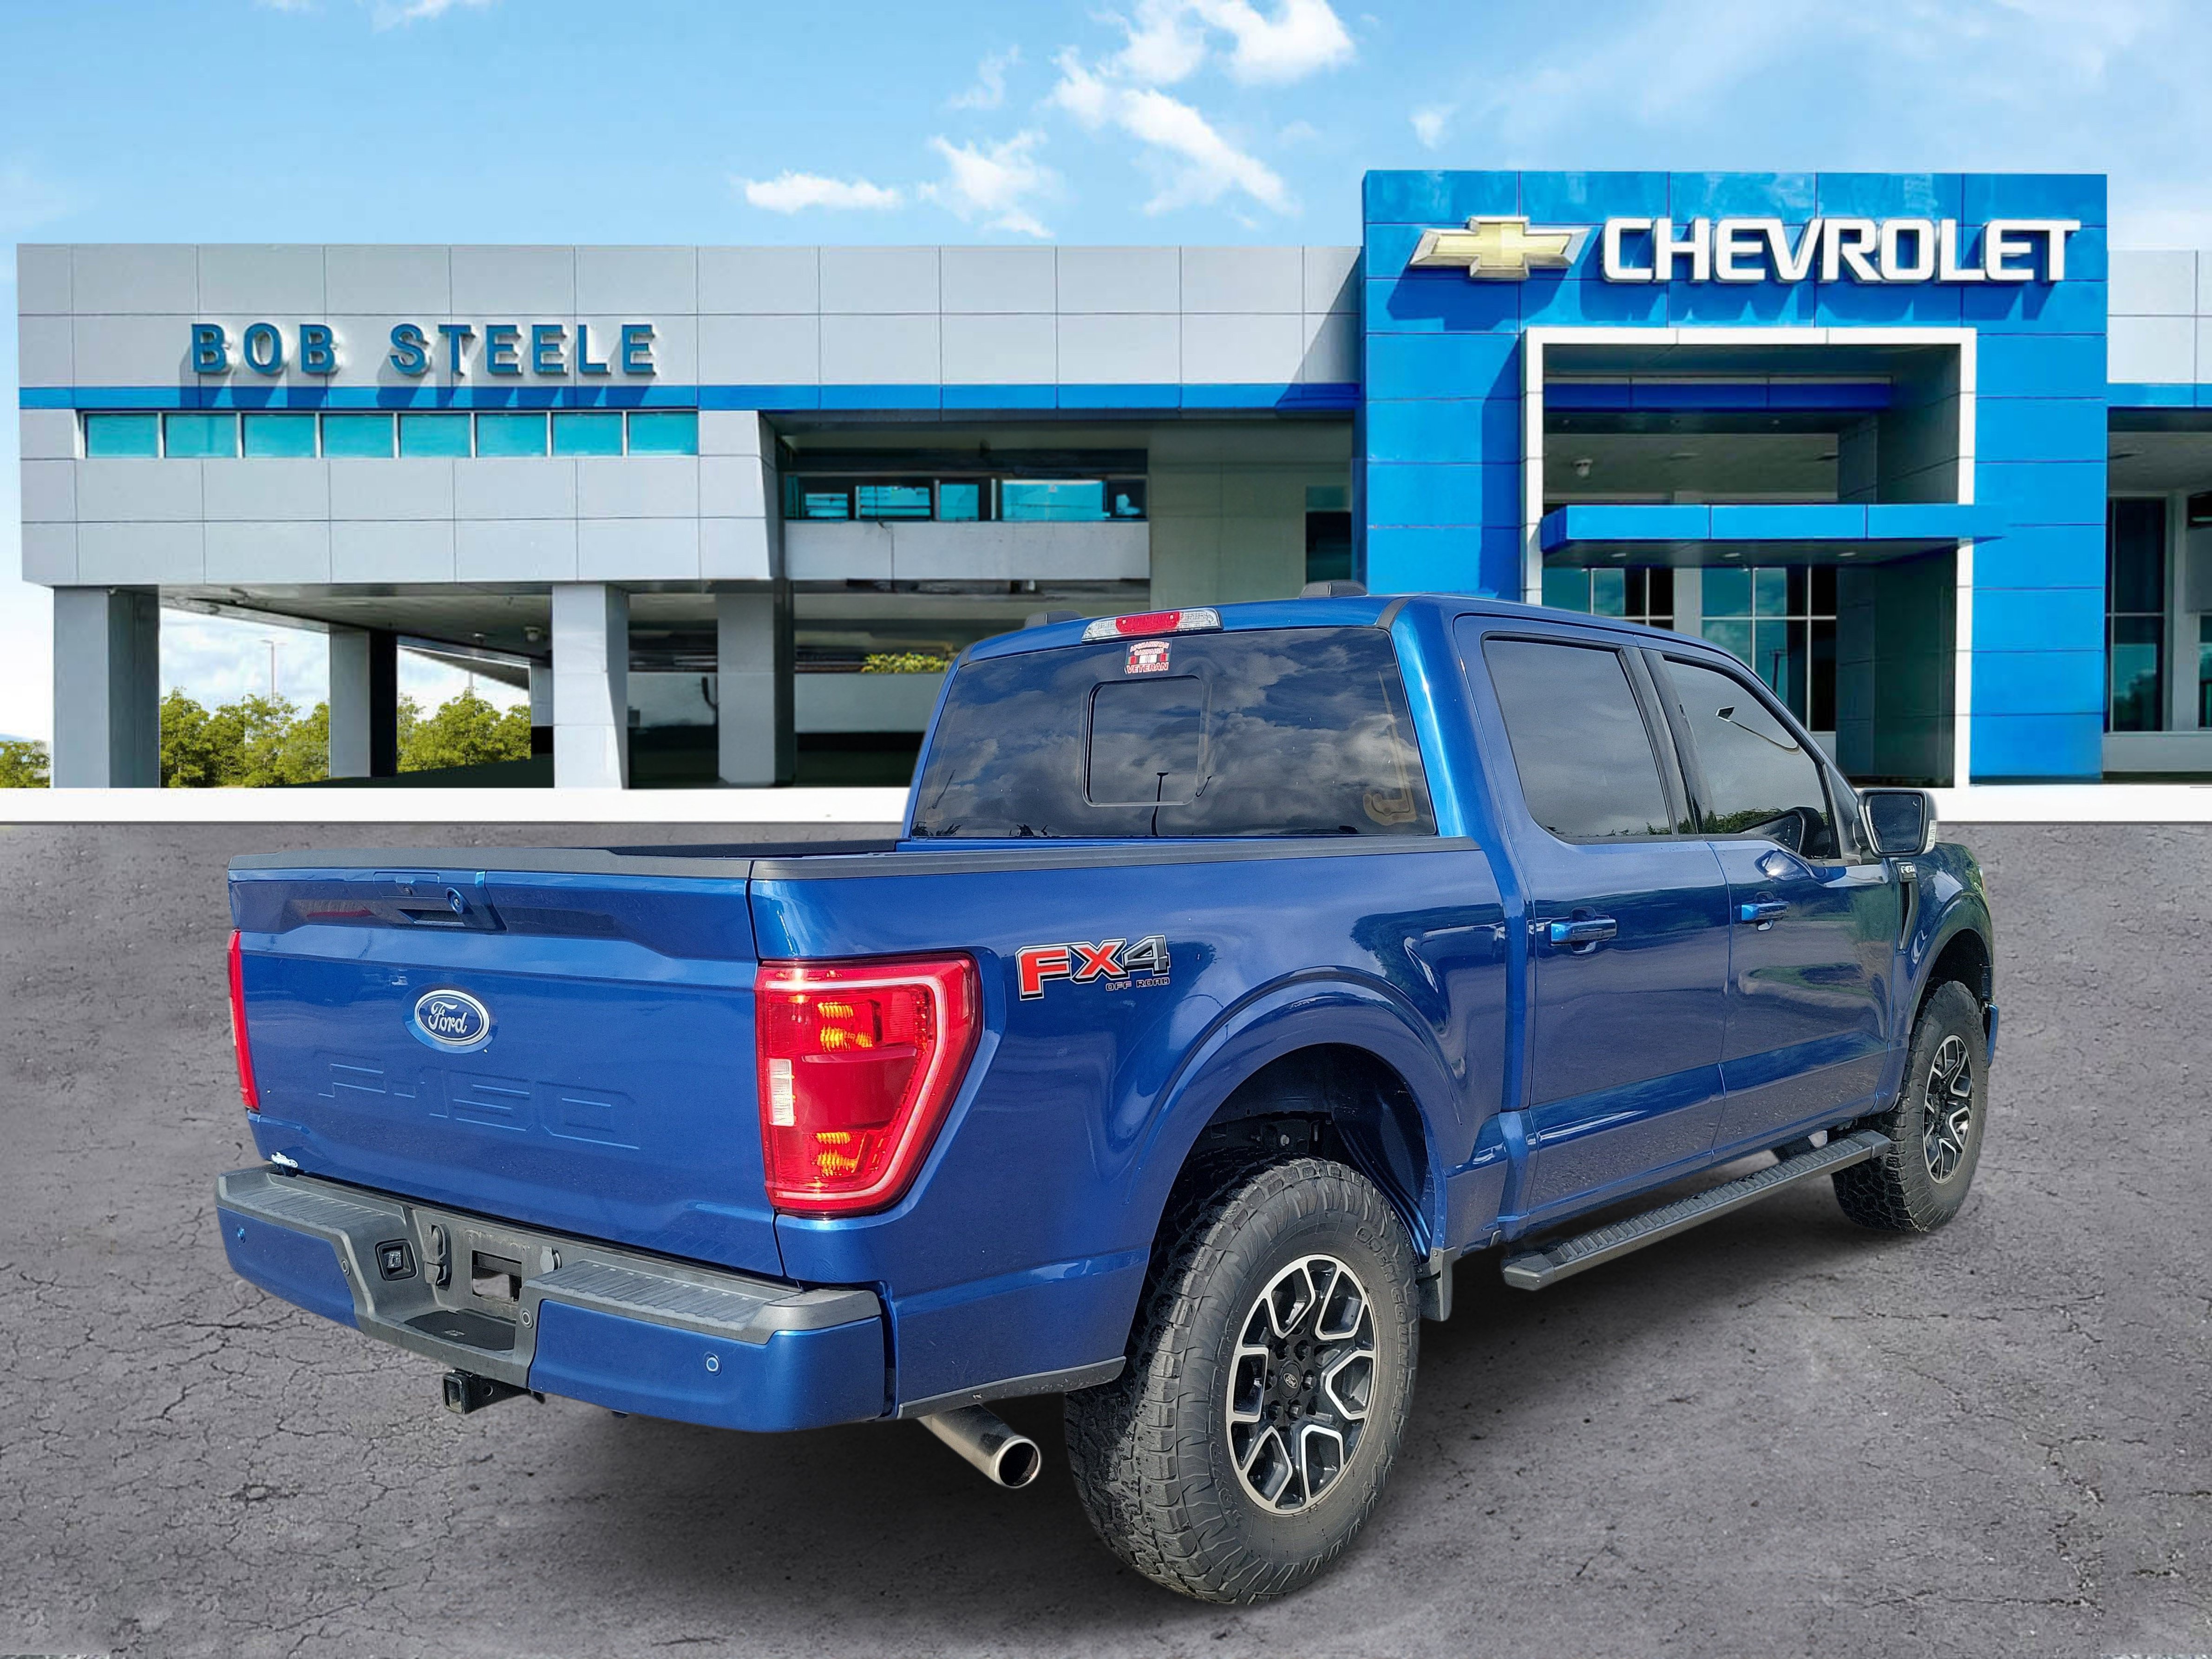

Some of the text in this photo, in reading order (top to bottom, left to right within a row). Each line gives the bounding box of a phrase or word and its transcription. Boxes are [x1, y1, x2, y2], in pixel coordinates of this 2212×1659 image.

[1603, 218, 2081, 282] CHEVROLET
[191, 322, 655, 375] BOB STEELE
[1130, 641, 1170, 653] AFGHANISTAN
[1134, 647, 1164, 656] CAMPAIGN
[1126, 662, 1169, 674] VETERAN
[1015, 934, 1171, 1001] FX4
[1106, 977, 1170, 991] OFF ROAD
[428, 1001, 467, 1033] Ford
[1355, 1226, 1398, 1283] OPEN
